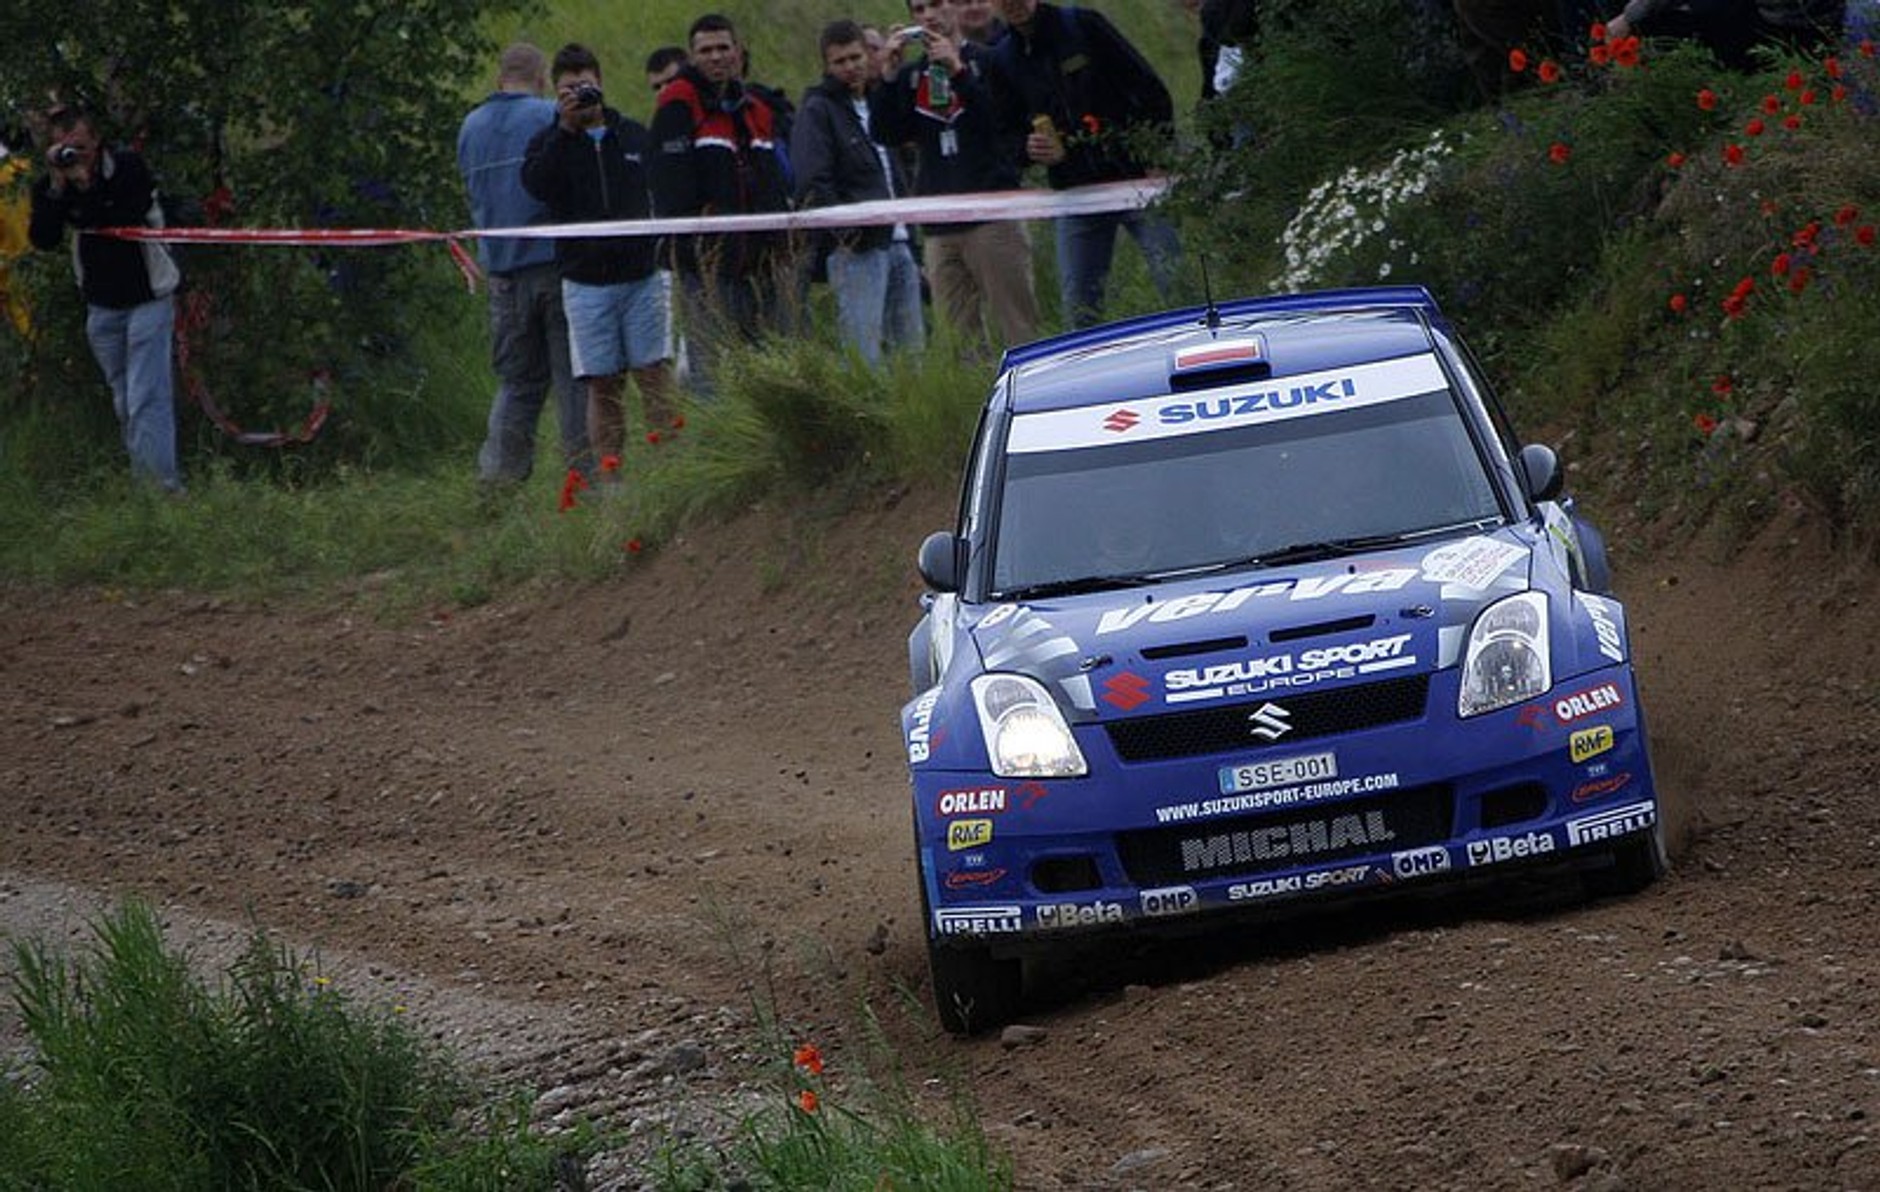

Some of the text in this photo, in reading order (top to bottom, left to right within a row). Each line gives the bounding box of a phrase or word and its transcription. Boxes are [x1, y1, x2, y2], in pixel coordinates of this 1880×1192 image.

[1158, 378, 1356, 425] SUZUKI
[1095, 568, 1420, 635] verva
[1165, 633, 1413, 690] SUZUKI SPORT
[1226, 666, 1356, 697] EUROPE
[1556, 685, 1621, 721] ORLEN
[1574, 729, 1608, 757] RMF
[1238, 757, 1331, 788] SSE-001
[940, 789, 1005, 815] ORLEN
[1156, 773, 1399, 823] WWW.SUZUKISPORT-EUROPE.COM
[952, 822, 987, 845] RMF
[1566, 800, 1656, 848] PIRELLI
[1181, 810, 1396, 872] MICHAL
[1492, 832, 1555, 863] Beta
[1399, 851, 1445, 874] OMP
[1228, 865, 1371, 901] SUZUKI SPORT
[1059, 900, 1124, 927] Beta
[1146, 890, 1193, 914] OMP
[935, 906, 1022, 935] PIRELLI
